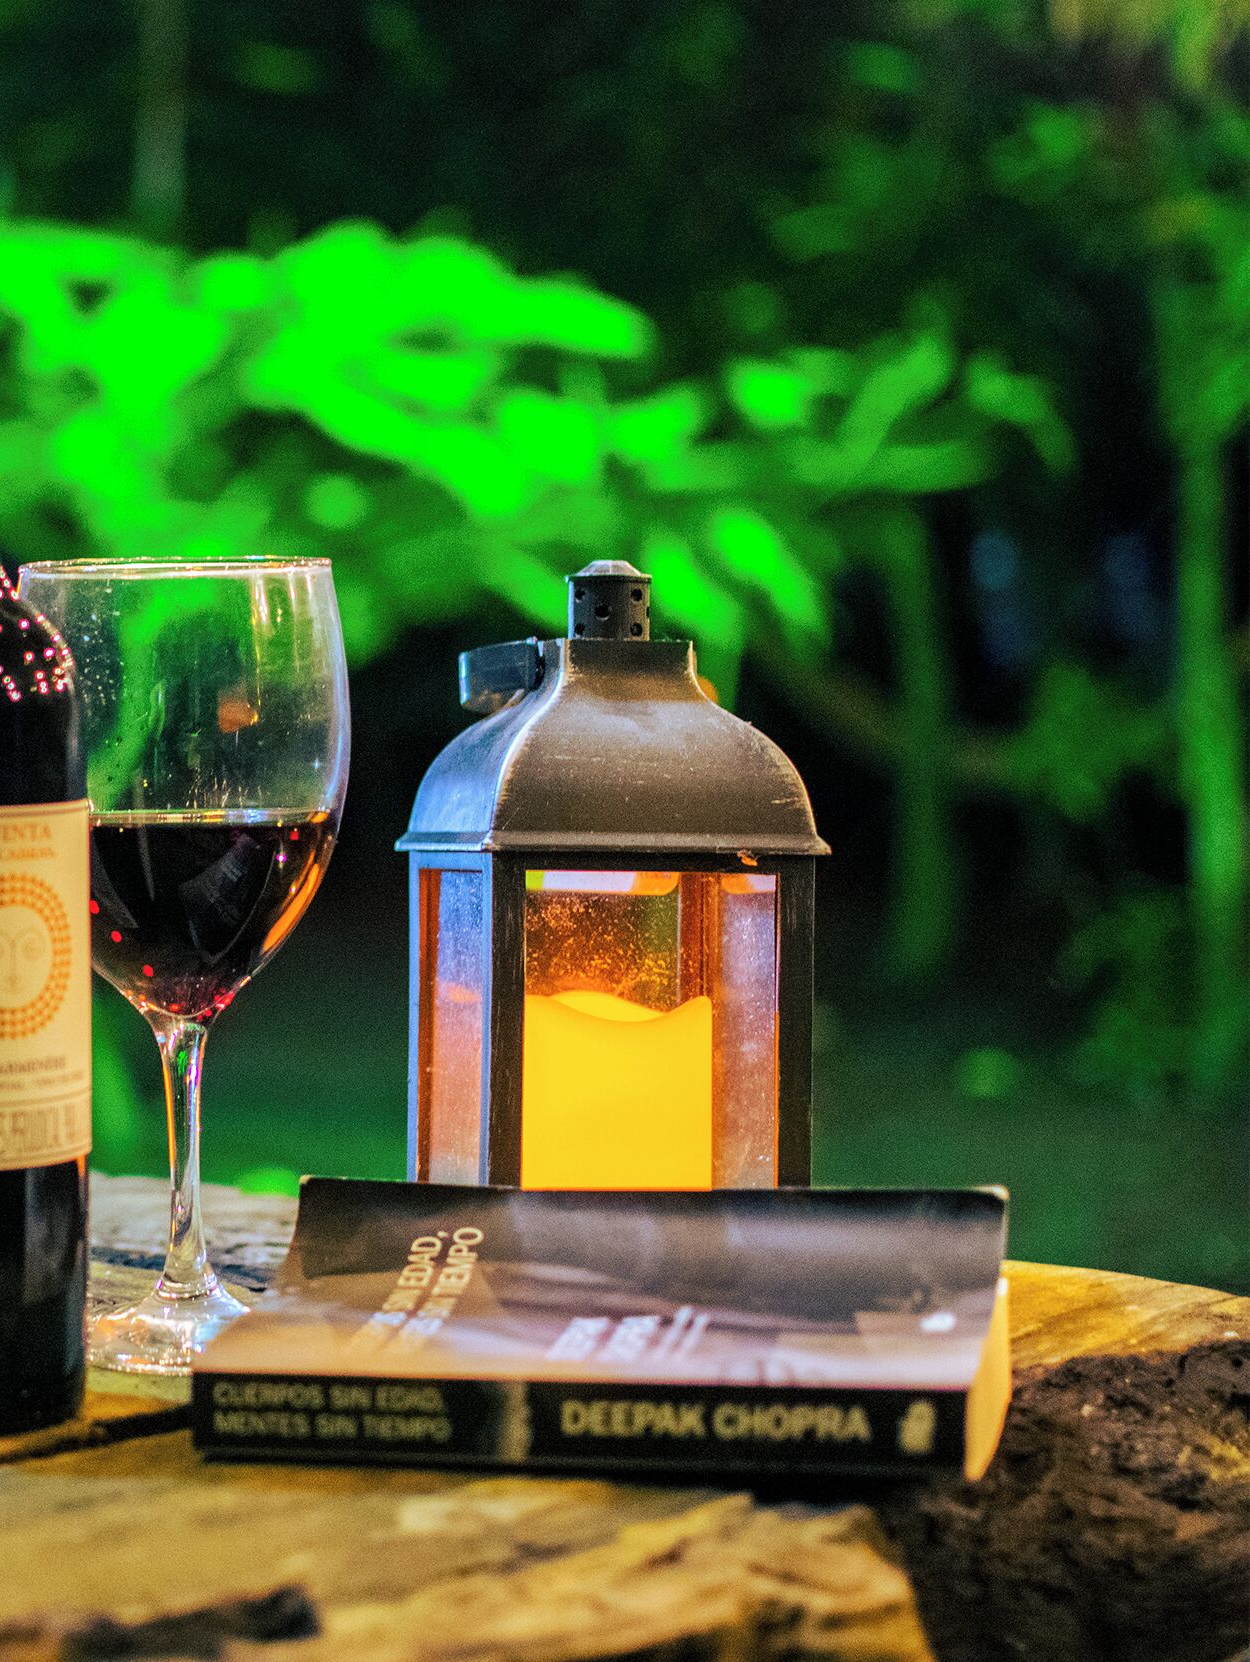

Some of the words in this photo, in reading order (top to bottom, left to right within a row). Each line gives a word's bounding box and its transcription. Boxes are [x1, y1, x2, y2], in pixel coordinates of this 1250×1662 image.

[397, 1231, 449, 1287] EDAD,
[213, 1382, 324, 1410] CUERPOS
[329, 1384, 371, 1410] SIN
[214, 1411, 310, 1437] MENTES
[314, 1413, 358, 1438] SIN
[362, 1415, 452, 1442] TIEMPO
[561, 1401, 705, 1438] DEEPAK
[712, 1402, 871, 1441] CHOPRA
